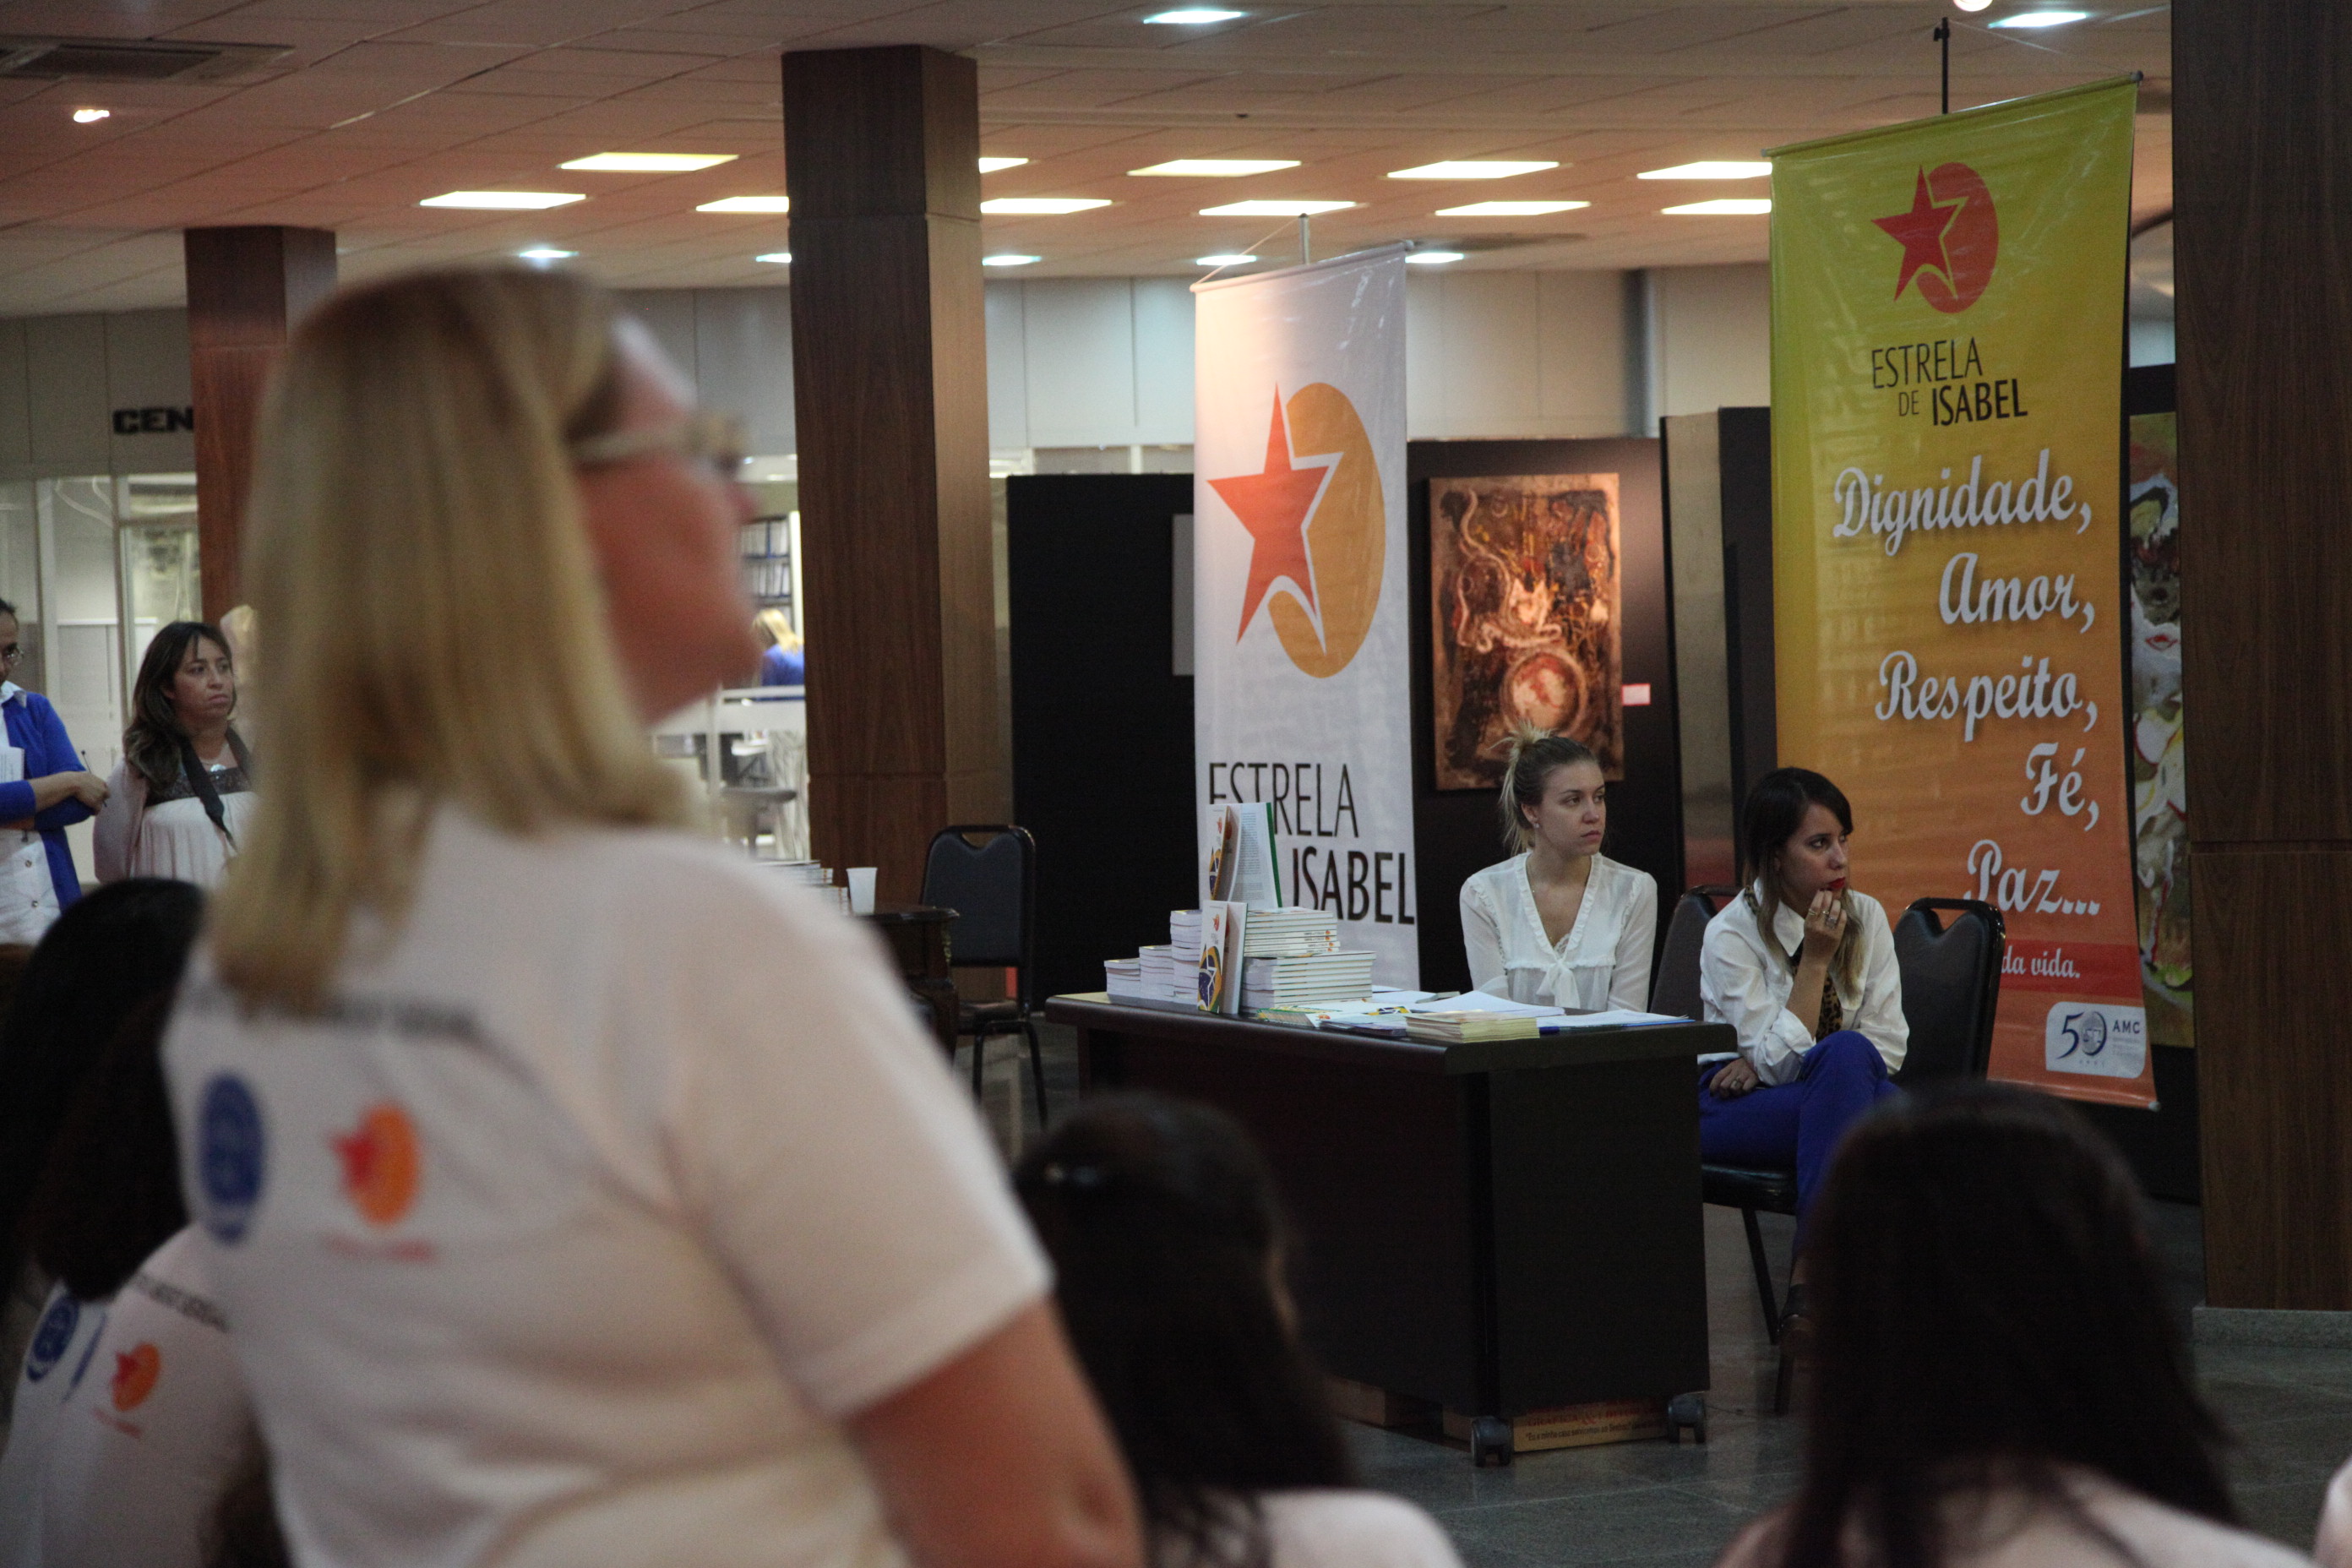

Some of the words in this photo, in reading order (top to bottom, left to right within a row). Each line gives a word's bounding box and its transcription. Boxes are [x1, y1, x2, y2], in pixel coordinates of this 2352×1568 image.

[1871, 337, 1983, 389] ESTRELA
[1897, 390, 1919, 416] DE
[1932, 378, 2028, 426] ISABEL
[1833, 448, 2092, 557] Dignidade,
[1939, 553, 2095, 634] Amor,
[1875, 651, 2098, 742] Respeito,
[1209, 762, 1359, 837] ESTRELA
[2020, 742, 2099, 831] Fé,
[1293, 846, 1415, 925] ISABEL
[1963, 839, 2100, 916] Paz...
[2031, 948, 2081, 978] vida.
[2056, 1011, 2107, 1059] 50
[2113, 1020, 2141, 1034] AMC
